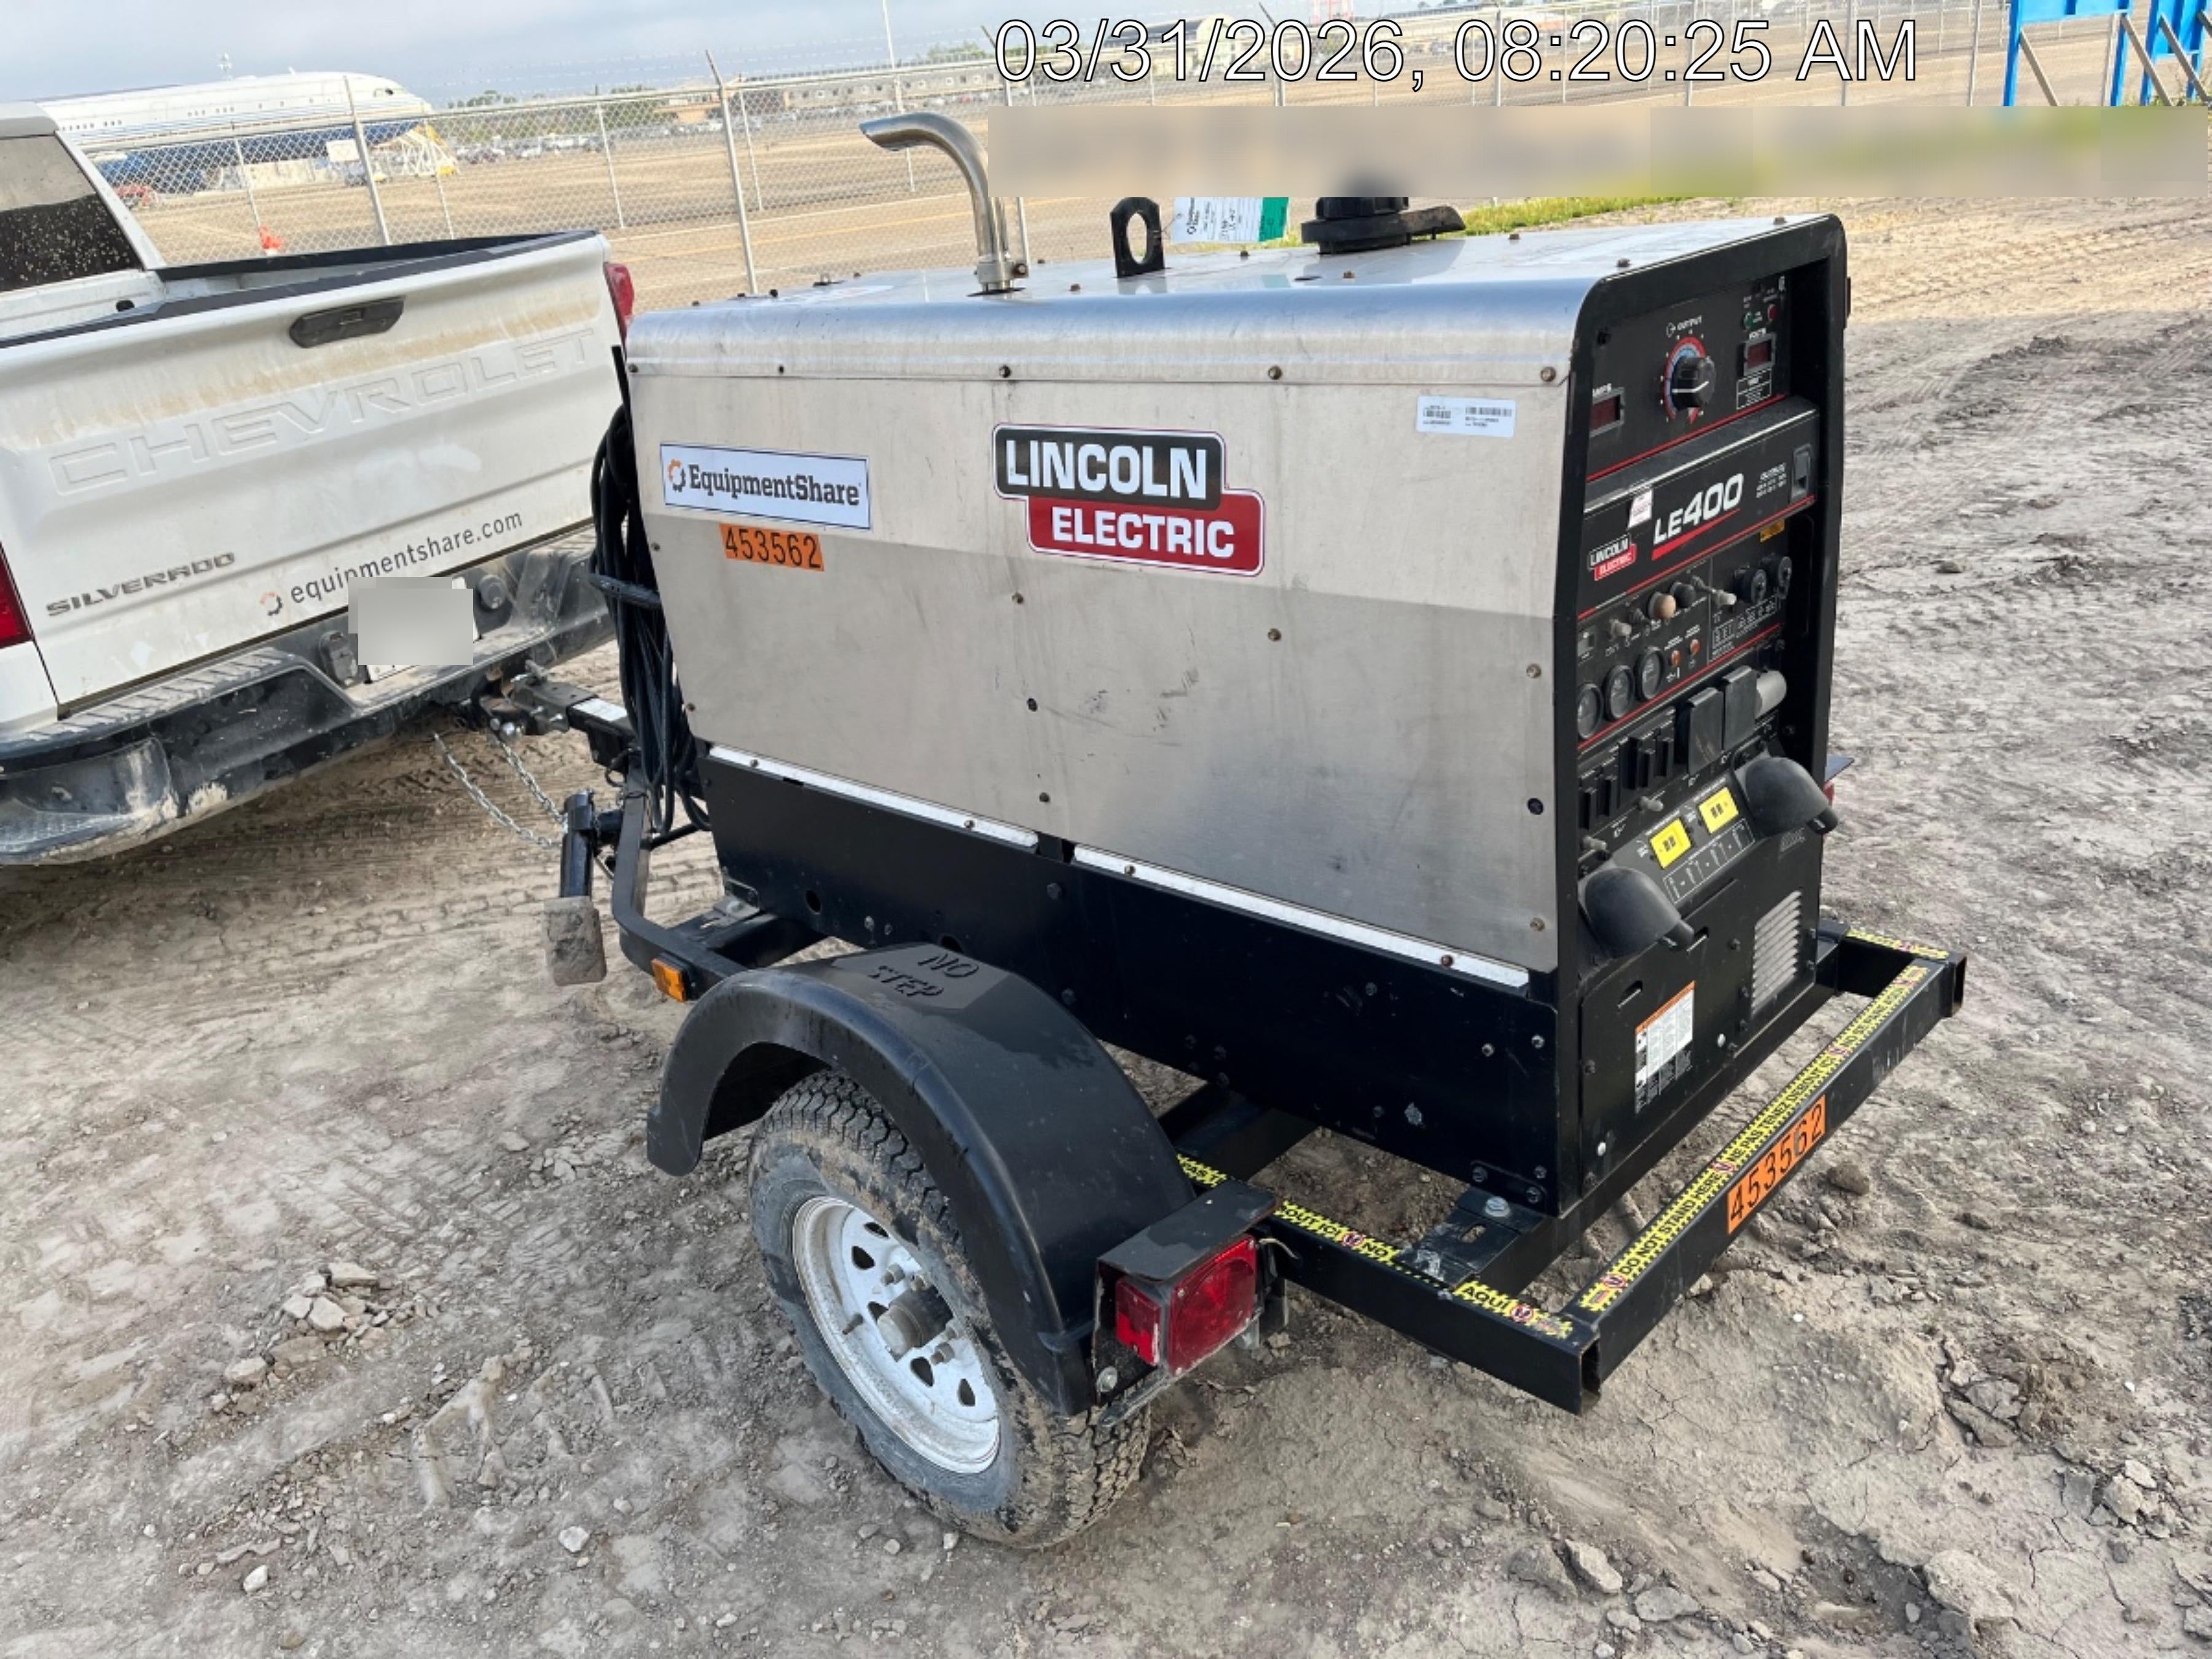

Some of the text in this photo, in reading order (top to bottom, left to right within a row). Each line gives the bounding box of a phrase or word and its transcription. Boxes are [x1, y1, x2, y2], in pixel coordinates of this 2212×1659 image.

[48, 327, 595, 495] CHEVROLET
[688, 464, 860, 506] EquipmentShare
[1005, 440, 1207, 500] LINCOLN
[1051, 506, 1235, 559] ELECTRIC
[1653, 473, 1744, 545] LE400
[725, 527, 821, 569] 453562
[1590, 536, 1630, 567] LINCOLN
[46, 551, 235, 617] SILVERADO
[868, 965, 944, 997] STEP
[917, 953, 979, 978] NO
[1730, 1104, 1821, 1222] 453562
[1362, 1241, 1388, 1257] NO
[1618, 1257, 1641, 1274] DO
[1635, 1233, 1662, 1257] NOT
[1658, 1199, 1698, 1233] STAND
[1690, 1172, 1722, 1199] HERE
